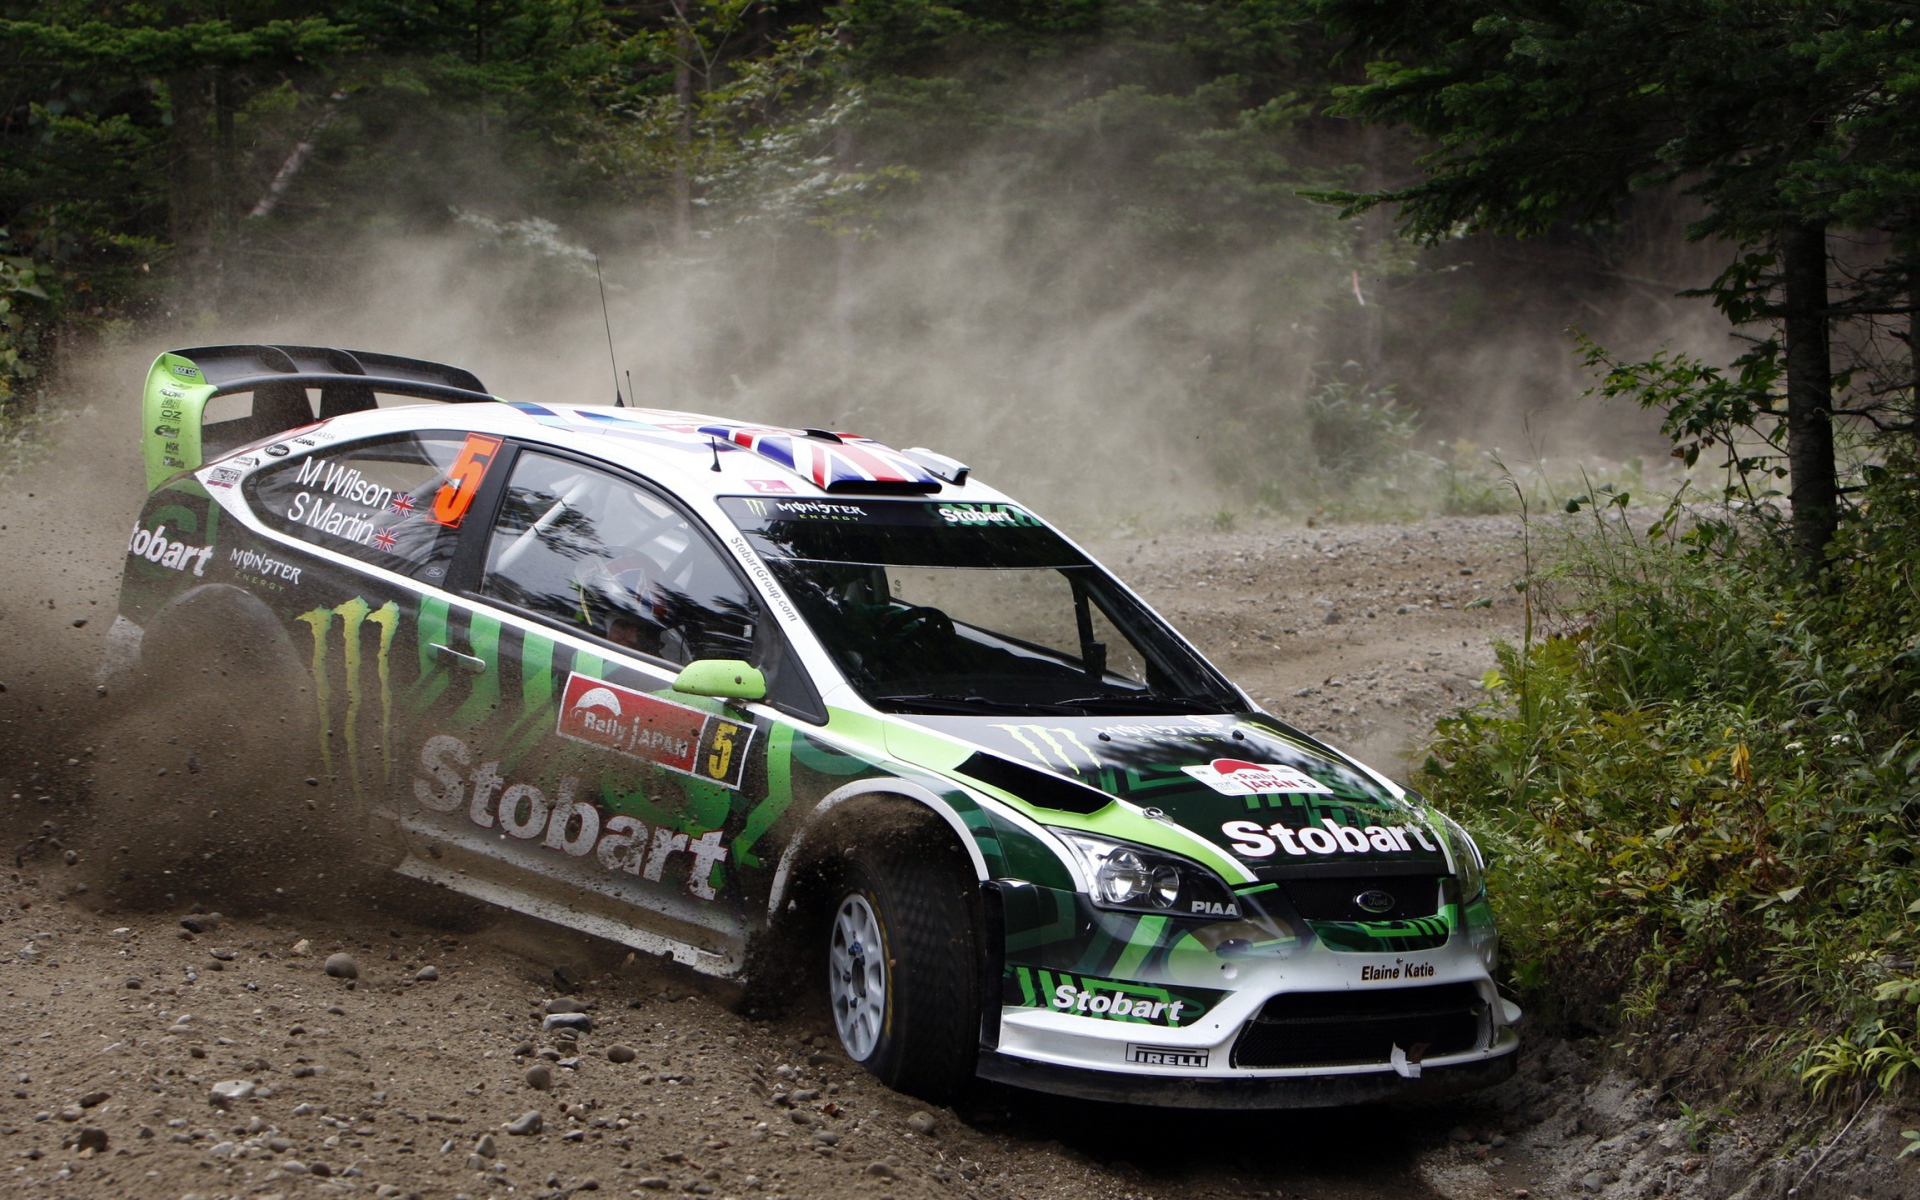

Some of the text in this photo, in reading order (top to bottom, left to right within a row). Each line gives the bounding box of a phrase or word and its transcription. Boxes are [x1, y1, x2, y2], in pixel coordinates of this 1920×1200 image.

[162, 410, 182, 419] OZ
[292, 438, 315, 446] SCANIA
[295, 456, 392, 510] M Wilson
[433, 437, 497, 522] 5
[288, 492, 374, 545] S Martin
[939, 507, 1015, 522] Stobart
[128, 520, 214, 577] tobart
[235, 572, 284, 592] ENERGY
[731, 537, 798, 622] StobartGroup.com
[584, 711, 627, 741] Rally
[709, 722, 738, 779] 5
[1238, 773, 1278, 781] Rally
[1298, 778, 1317, 789] 5
[413, 734, 729, 900] Stobart
[1222, 818, 1437, 857] Stobart
[1191, 901, 1238, 916] PIAA
[1361, 962, 1434, 981] Elaine Katie
[1052, 984, 1184, 1021] Stobart
[1126, 1043, 1209, 1067] PIRELLI
